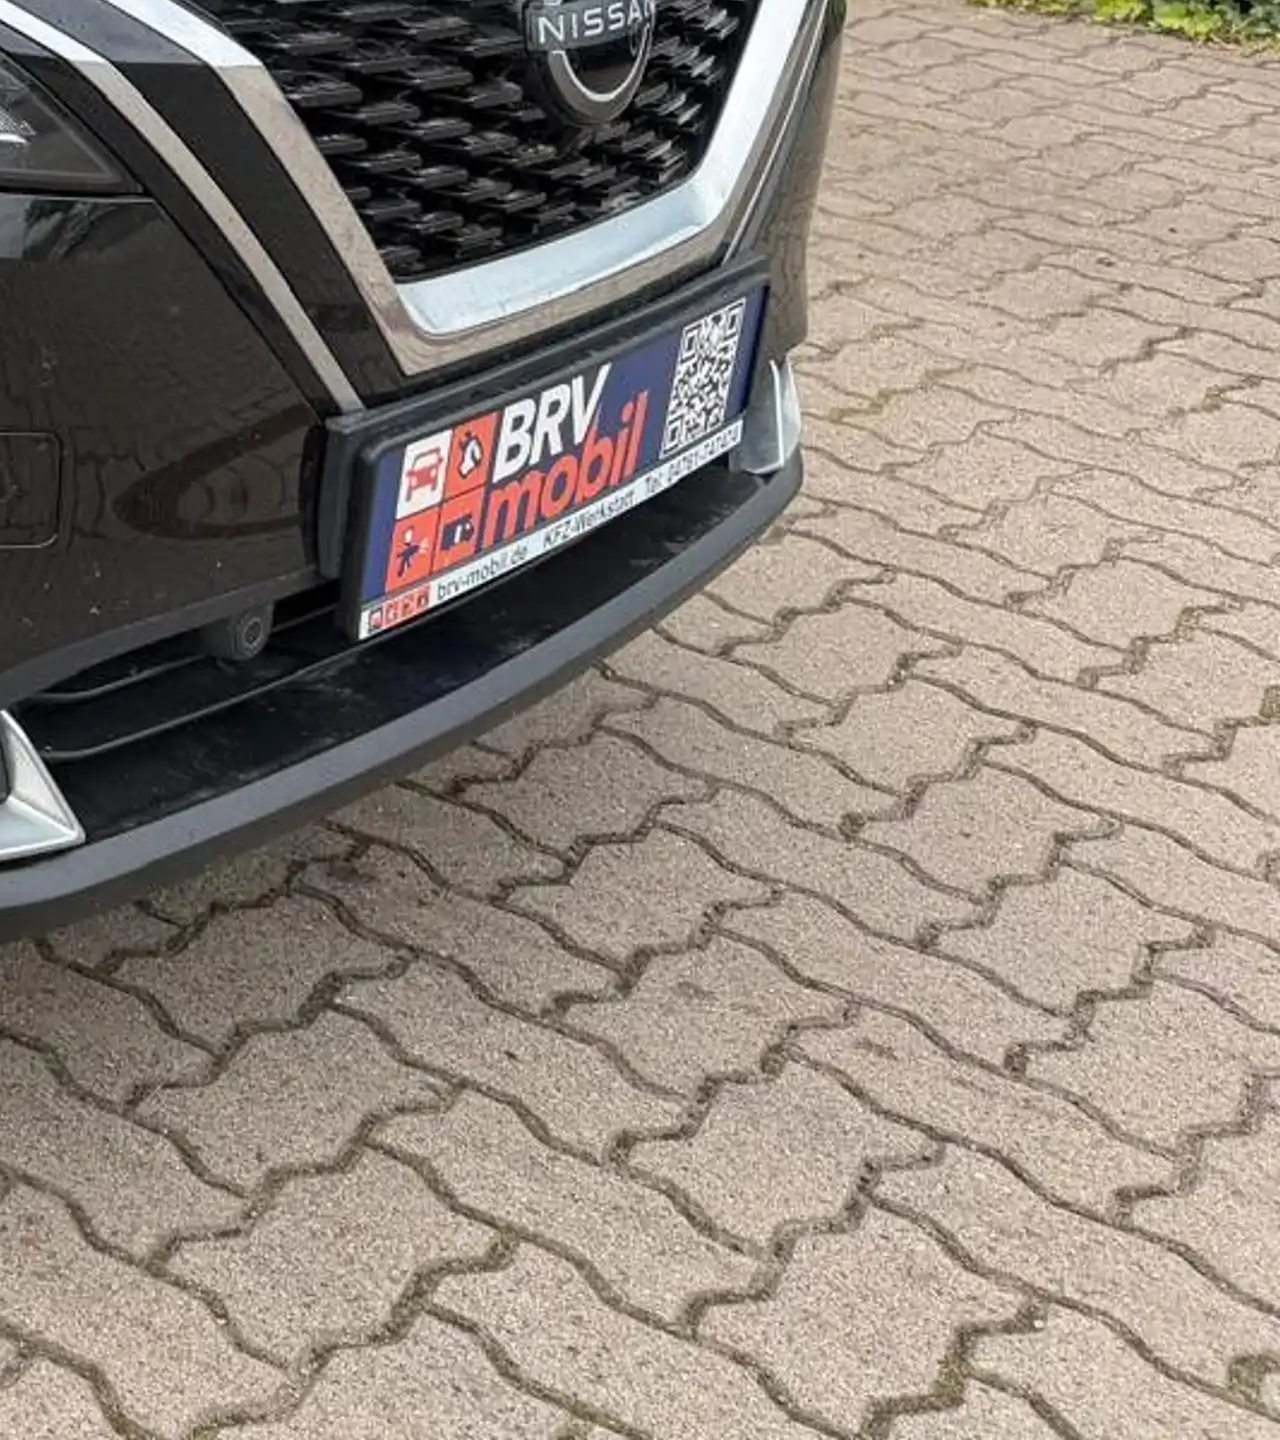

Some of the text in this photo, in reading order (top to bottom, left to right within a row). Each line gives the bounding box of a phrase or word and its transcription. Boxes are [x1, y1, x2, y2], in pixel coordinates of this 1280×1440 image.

[482, 389, 649, 549] mobil
[492, 361, 613, 484] BRV
[436, 544, 528, 600] brv-mobil.de
